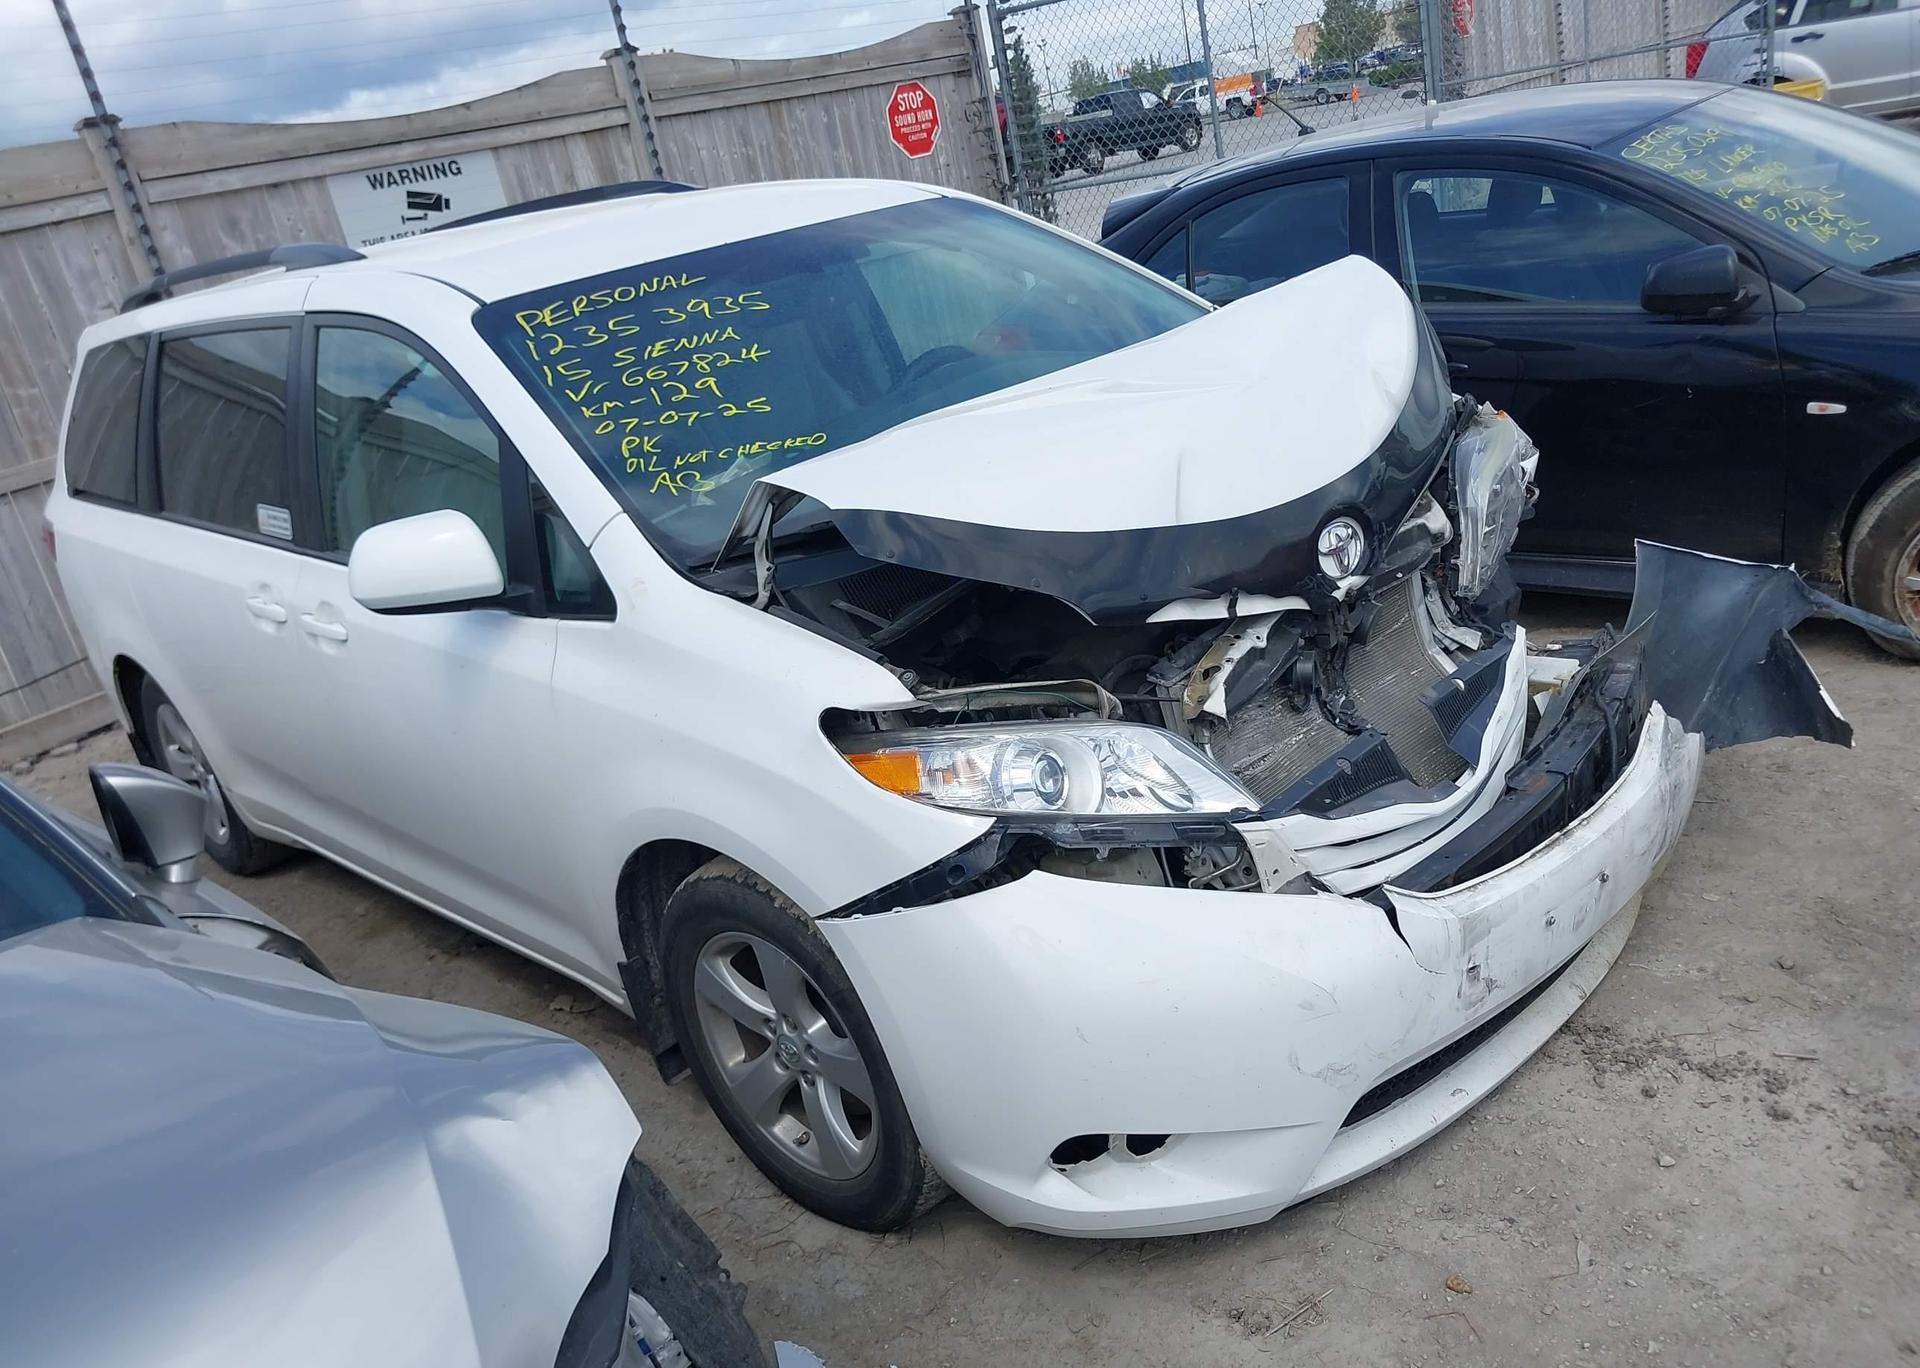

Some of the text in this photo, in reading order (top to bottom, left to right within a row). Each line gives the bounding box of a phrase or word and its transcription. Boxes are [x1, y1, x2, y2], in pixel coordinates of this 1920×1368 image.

[894, 112, 916, 127] SOUND
[897, 90, 923, 112] STOP
[366, 160, 462, 191] WARNING
[515, 273, 707, 337] PERSONAL
[525, 290, 771, 361] 1235 3935
[542, 326, 742, 387] 15 SIENNA
[621, 343, 772, 387] 667824
[594, 396, 773, 435] 07-07-25
[621, 434, 664, 458] PK
[626, 432, 828, 473] OIL NOT CHECKED
